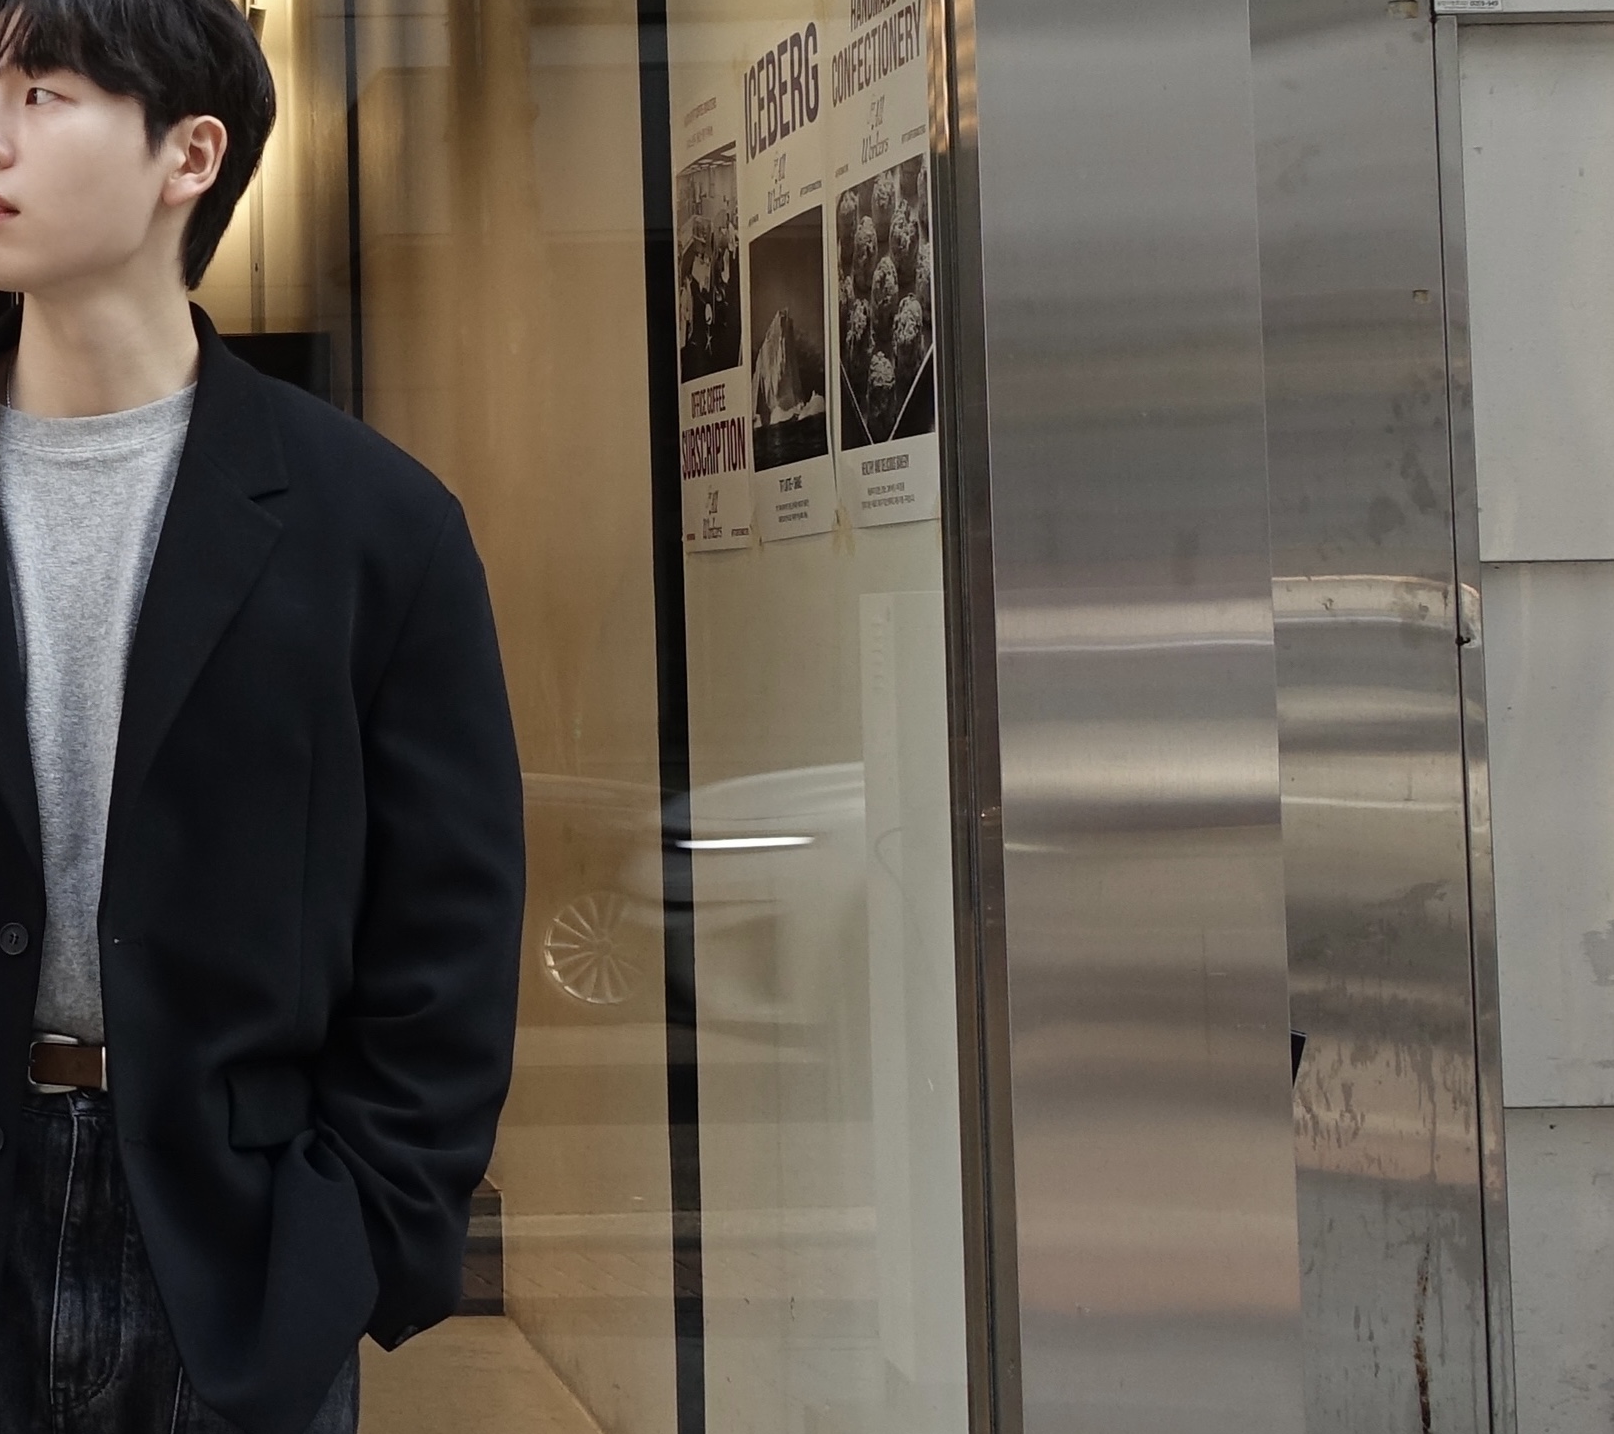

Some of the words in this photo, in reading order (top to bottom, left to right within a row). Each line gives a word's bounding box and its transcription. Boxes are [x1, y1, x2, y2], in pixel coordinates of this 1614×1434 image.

[743, 21, 820, 164] ICEBERG
[707, 383, 726, 414] COFFEE
[682, 416, 747, 480] SUBSCRIPTION
